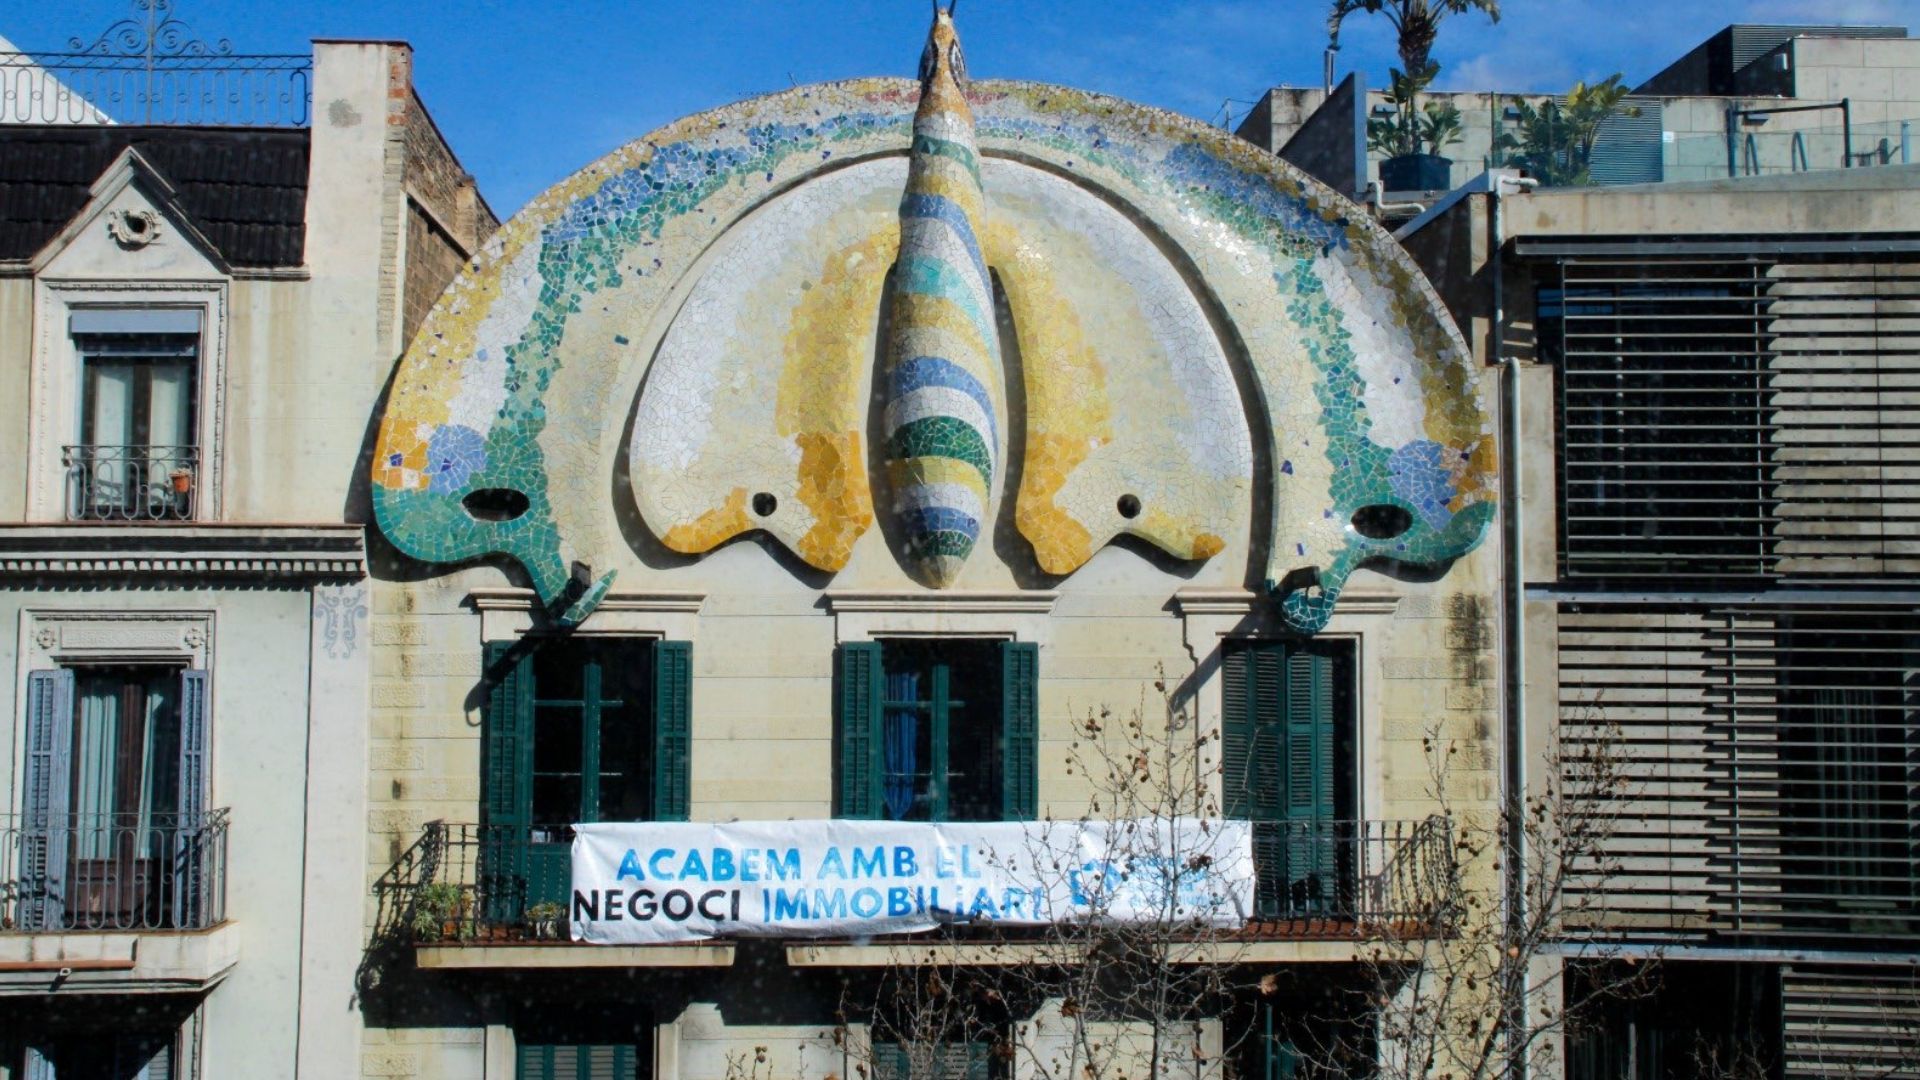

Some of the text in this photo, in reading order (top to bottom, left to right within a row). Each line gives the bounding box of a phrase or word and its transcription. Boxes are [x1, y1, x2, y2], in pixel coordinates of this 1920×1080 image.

[617, 845, 981, 881] ACABEM AMB EL
[573, 889, 740, 922] NEGOCI
